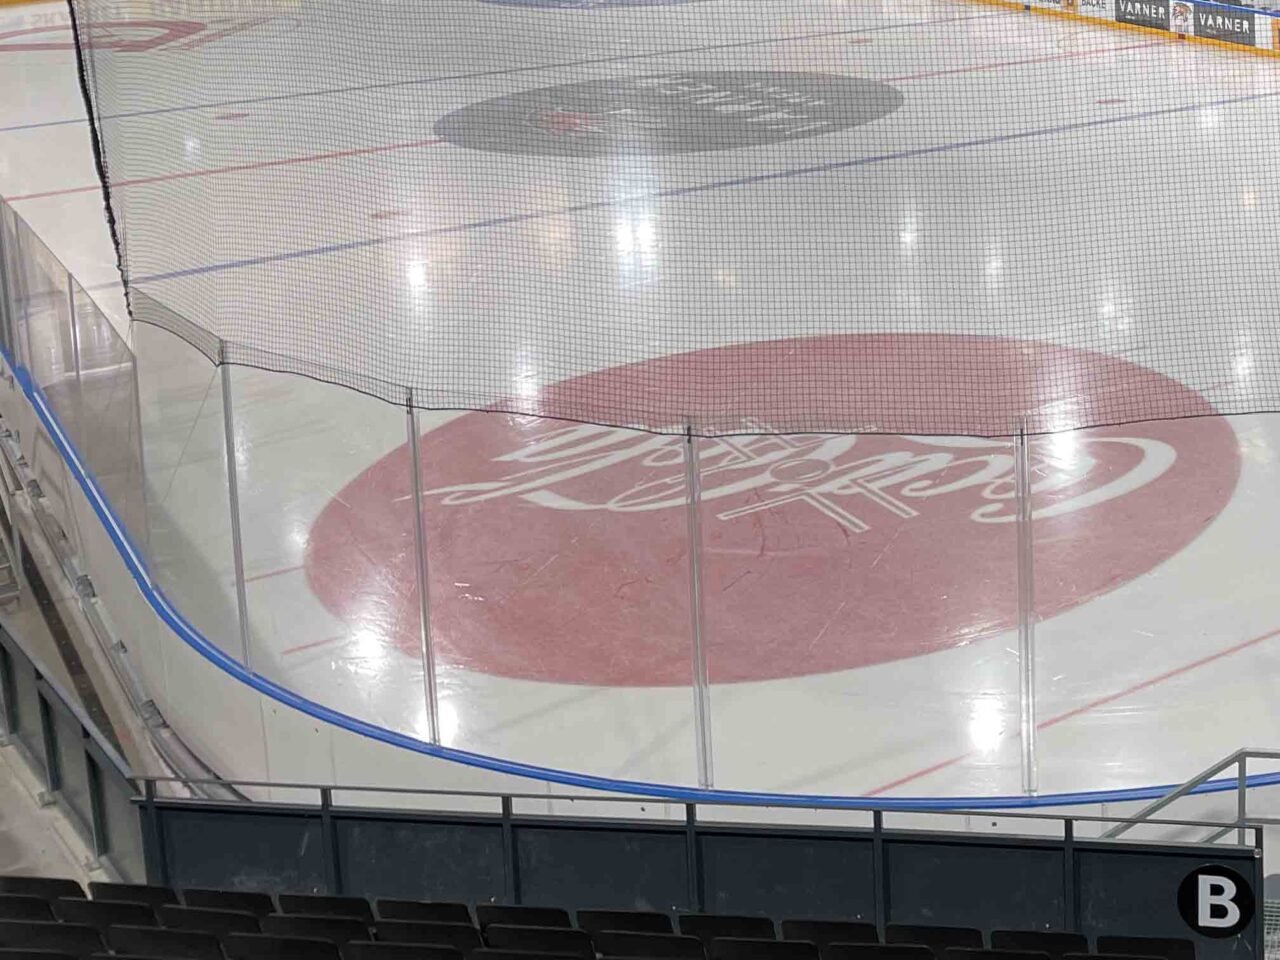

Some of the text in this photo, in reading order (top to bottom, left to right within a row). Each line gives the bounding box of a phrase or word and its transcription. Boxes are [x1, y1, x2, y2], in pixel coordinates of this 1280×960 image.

[1119, 0, 1165, 20] VARNER
[1199, 12, 1251, 34] VARNER
[1197, 874, 1241, 929] B
